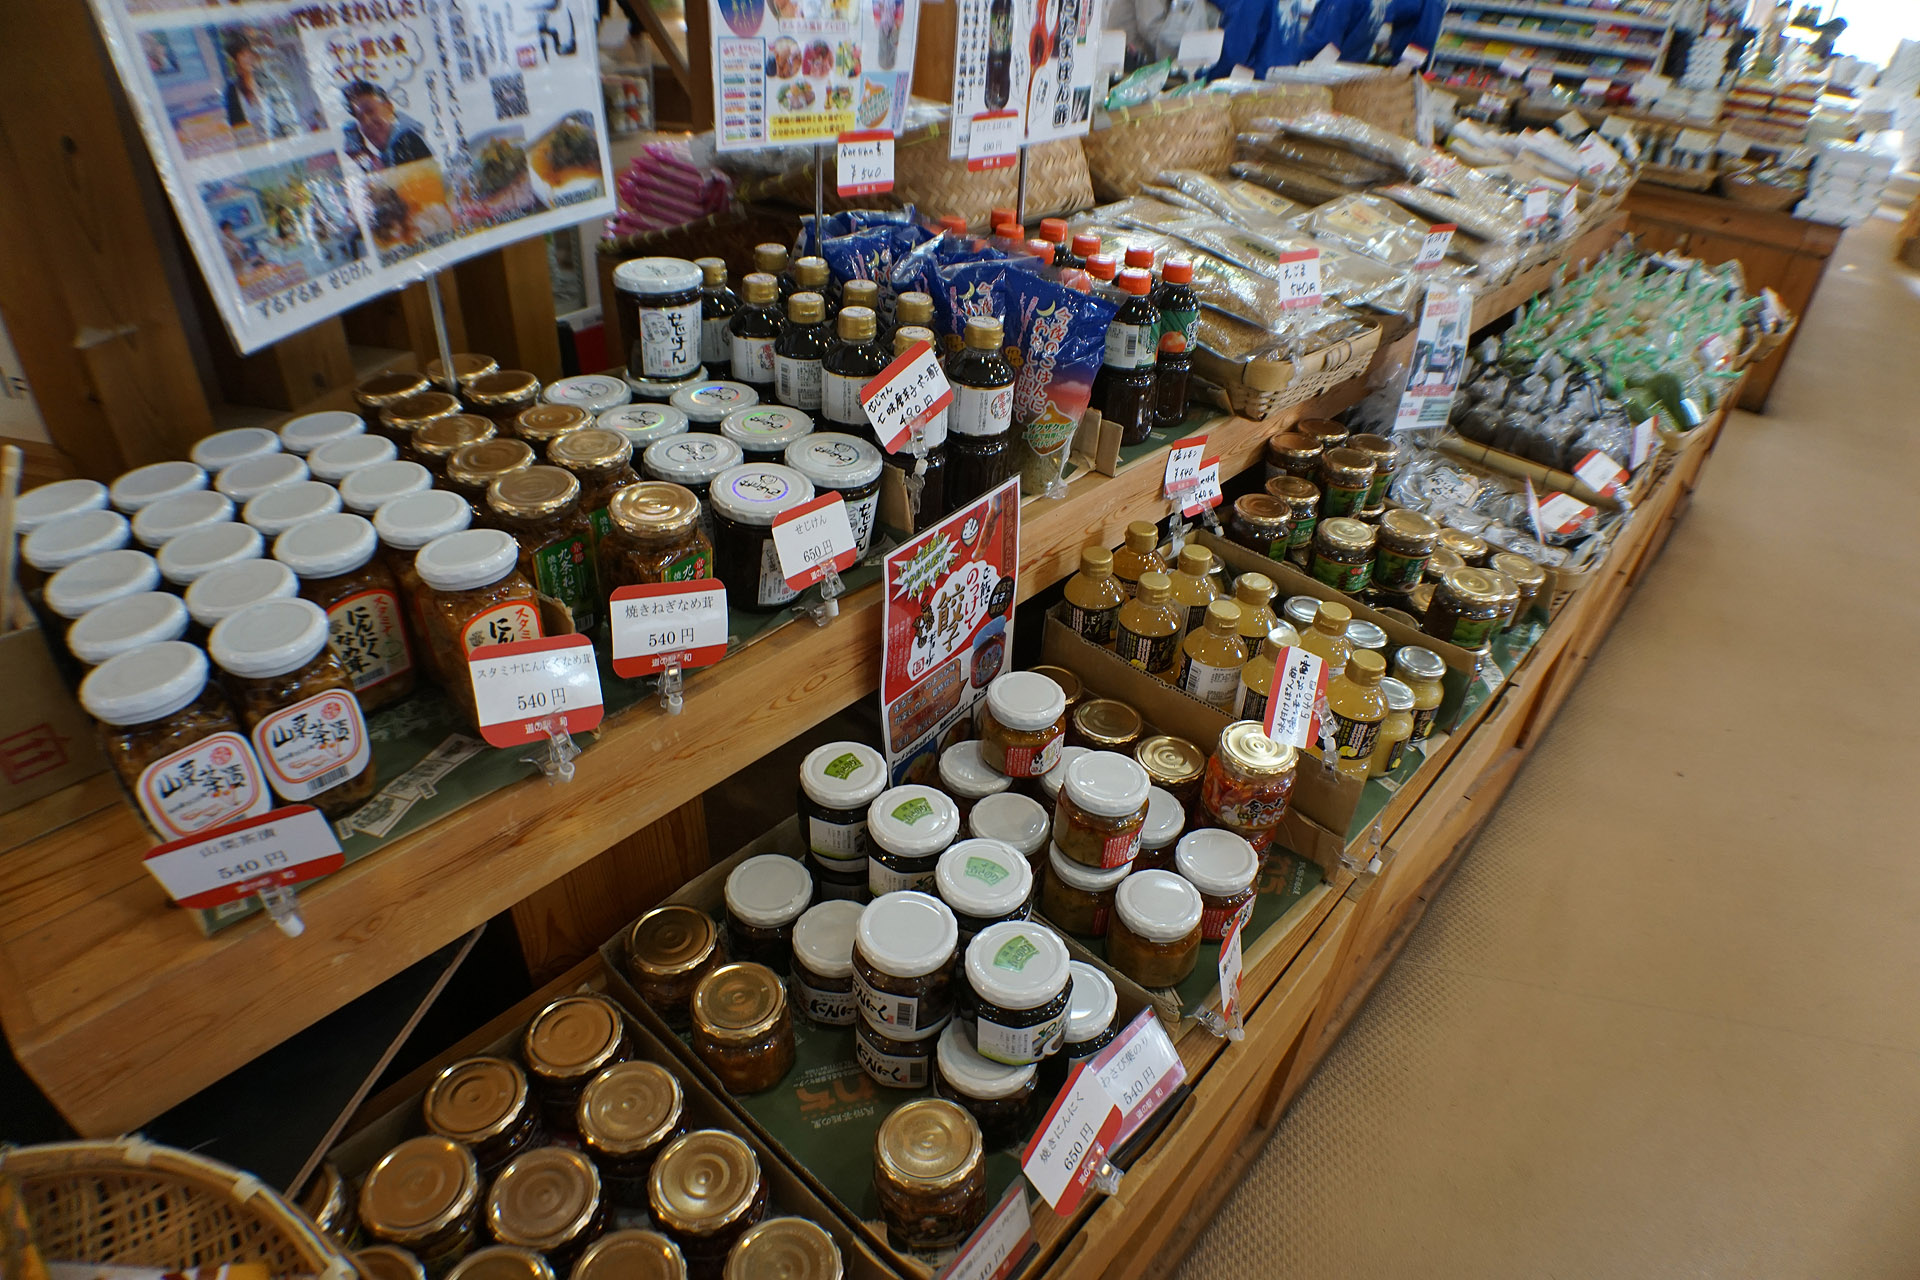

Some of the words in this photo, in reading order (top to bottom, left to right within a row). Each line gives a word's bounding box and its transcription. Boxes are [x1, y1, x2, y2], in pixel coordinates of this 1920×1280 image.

[794, 514, 827, 535] せじけん
[803, 546, 822, 563] 650
[822, 539, 834, 556] 円
[625, 596, 715, 620] 焼きねぎなめ茸
[964, 567, 980, 631] のっけて
[346, 606, 381, 659] にんにく
[936, 583, 966, 652] 餃子
[648, 631, 676, 648] 540
[681, 627, 695, 644] 円
[476, 653, 592, 680] スタミナにんにくなめ茸
[683, 653, 693, 663] 和
[517, 692, 547, 711] 540
[551, 687, 567, 706] 円
[1277, 666, 1298, 735] 味付けぽん酢
[1300, 692, 1313, 720] 540
[271, 713, 351, 749] 山菜茶漬
[157, 759, 247, 800] 山菜茶漬
[199, 827, 276, 859] 山菜茶漬
[217, 858, 260, 880] 540
[263, 850, 288, 867] 円
[1100, 1036, 1149, 1089] わさび葉のり
[1122, 1079, 1144, 1106] 540
[1142, 1066, 1156, 1086] 円
[1135, 1098, 1154, 1120] 道の駅
[1040, 1091, 1085, 1165] 焼きにんにく
[1063, 1141, 1083, 1172] 650
[1079, 1122, 1094, 1143] 円
